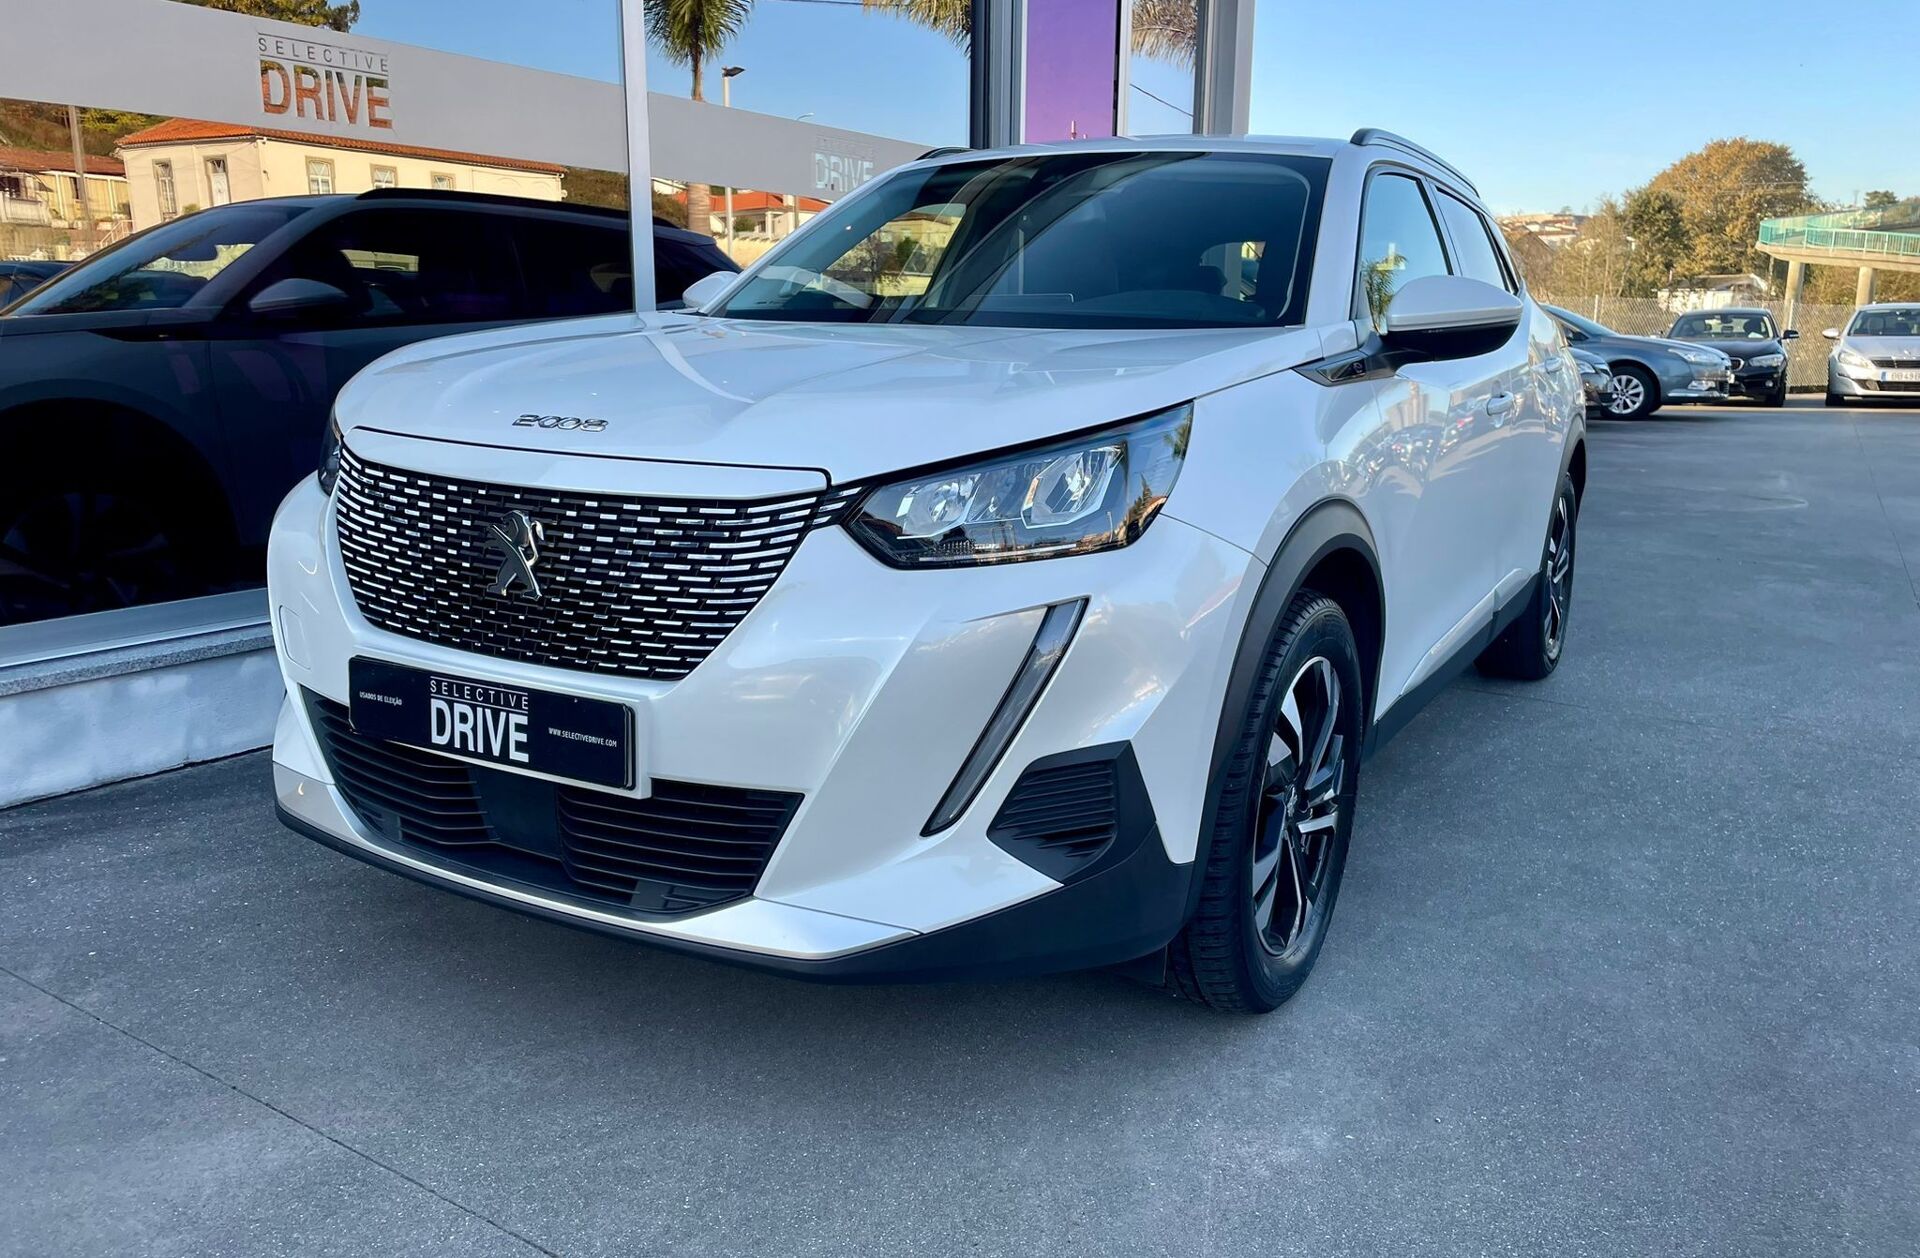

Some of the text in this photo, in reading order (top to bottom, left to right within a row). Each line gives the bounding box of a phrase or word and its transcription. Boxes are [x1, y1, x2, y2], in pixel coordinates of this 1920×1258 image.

[258, 37, 388, 73] SELECTIVE
[259, 59, 392, 129] DRIVE
[512, 413, 609, 433] 2008
[430, 680, 528, 710] SELECTIVE
[430, 698, 529, 763] DRIVE
[548, 727, 617, 747] WWW.SELECTIVEDRIVE.COM
